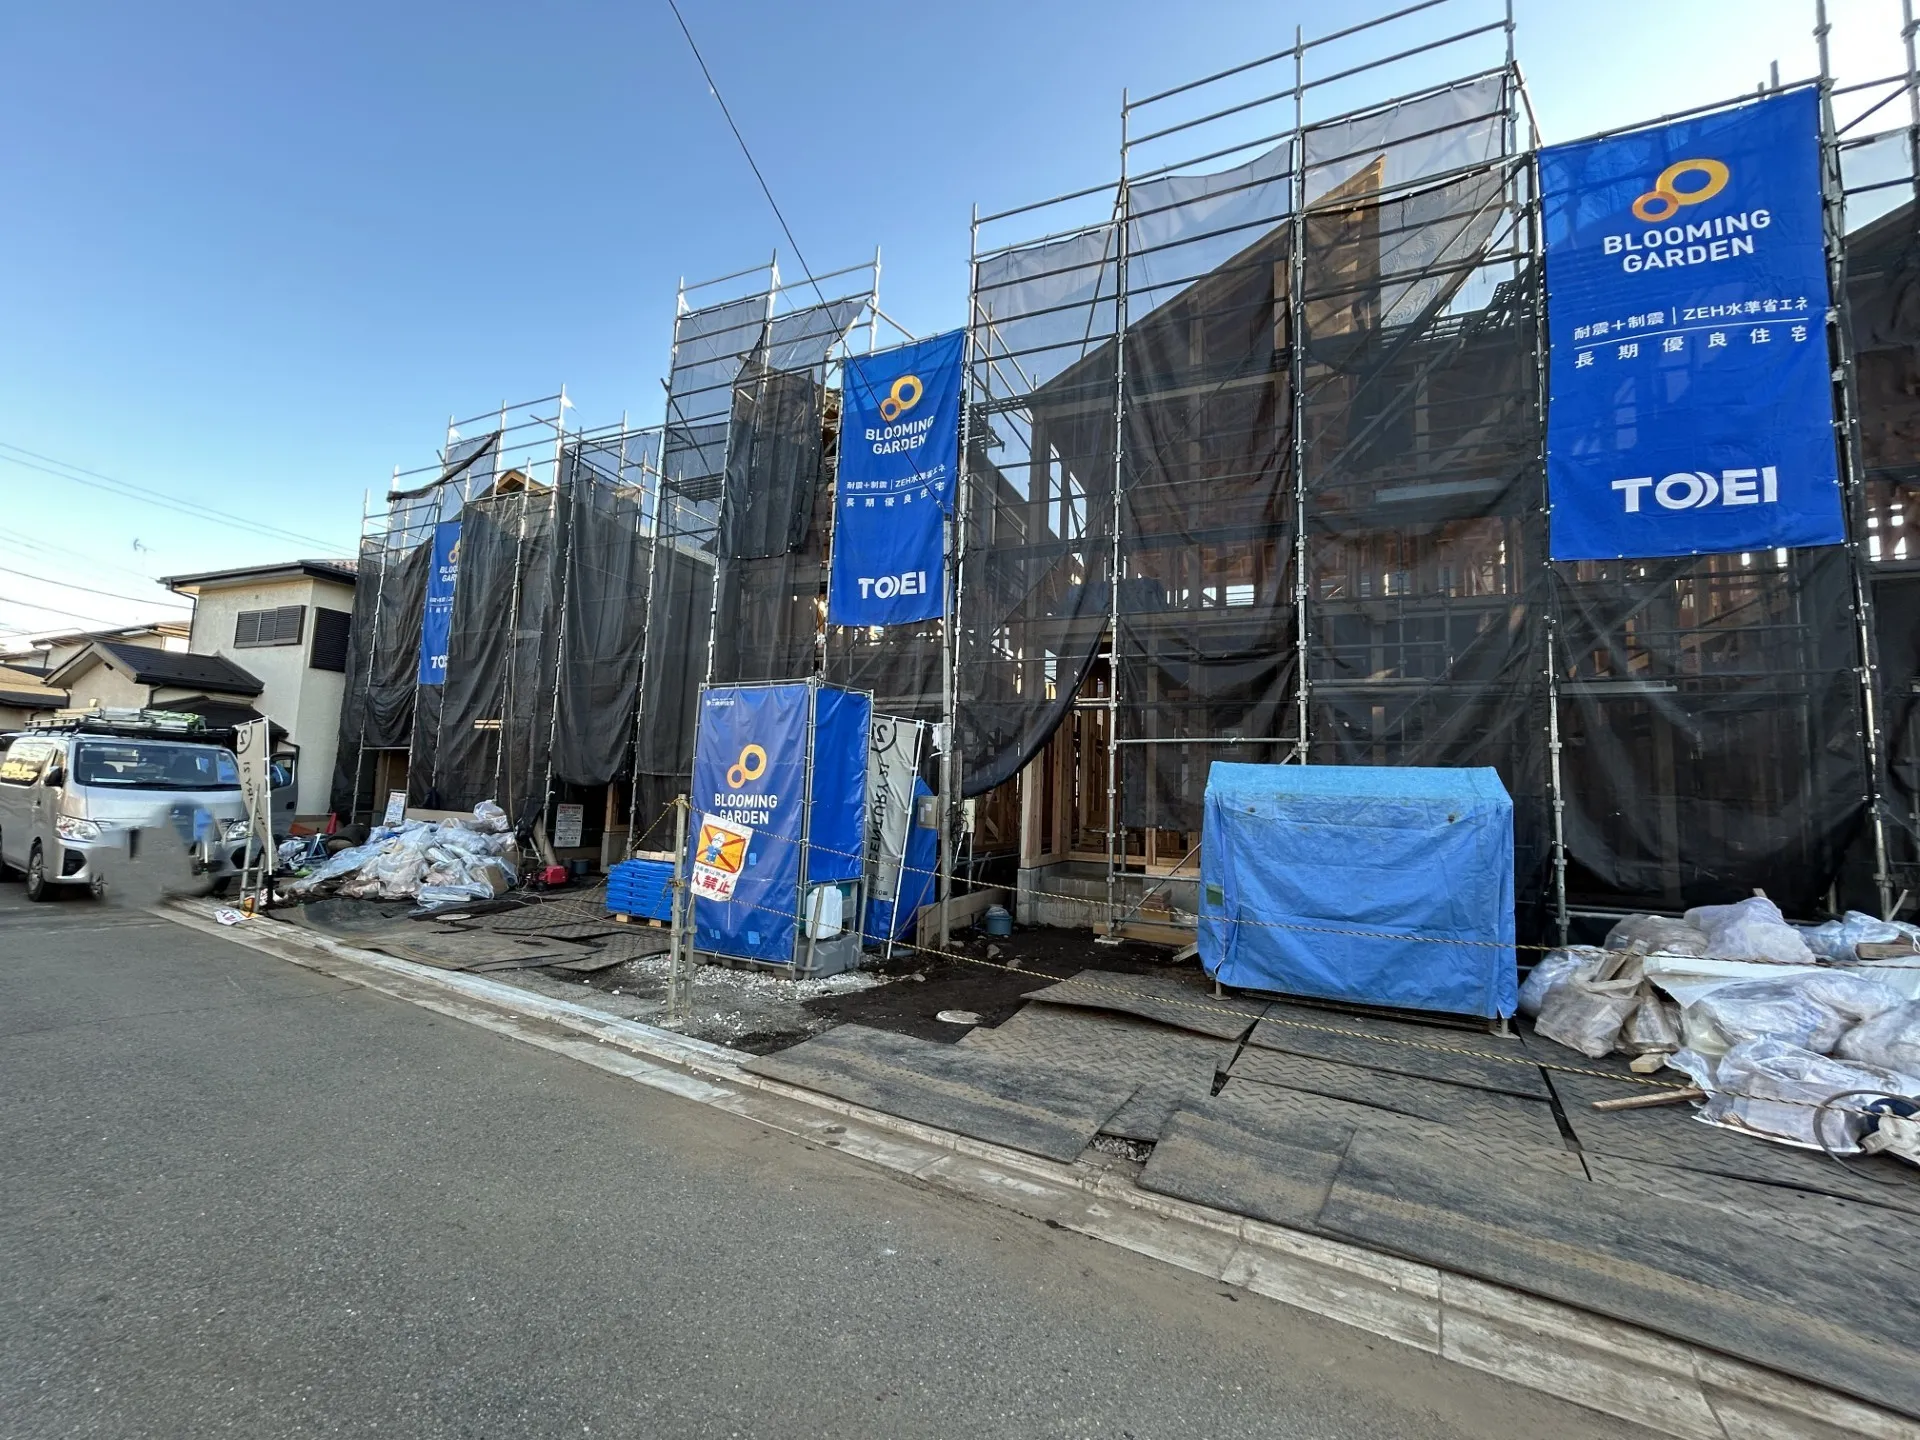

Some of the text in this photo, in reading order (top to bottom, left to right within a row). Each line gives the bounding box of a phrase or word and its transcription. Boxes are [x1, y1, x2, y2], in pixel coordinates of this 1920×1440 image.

[1603, 209, 1771, 255] BLOOMING
[1622, 235, 1754, 273] GARDEN
[1574, 325, 1808, 369] 長期優良住宅
[865, 415, 934, 441] BLOOMING
[872, 432, 927, 454] GARDEN
[1611, 465, 1777, 513] TOEI
[858, 571, 927, 600] TOEI
[714, 793, 778, 809] BLOOMING
[720, 809, 769, 825] GARDEN
